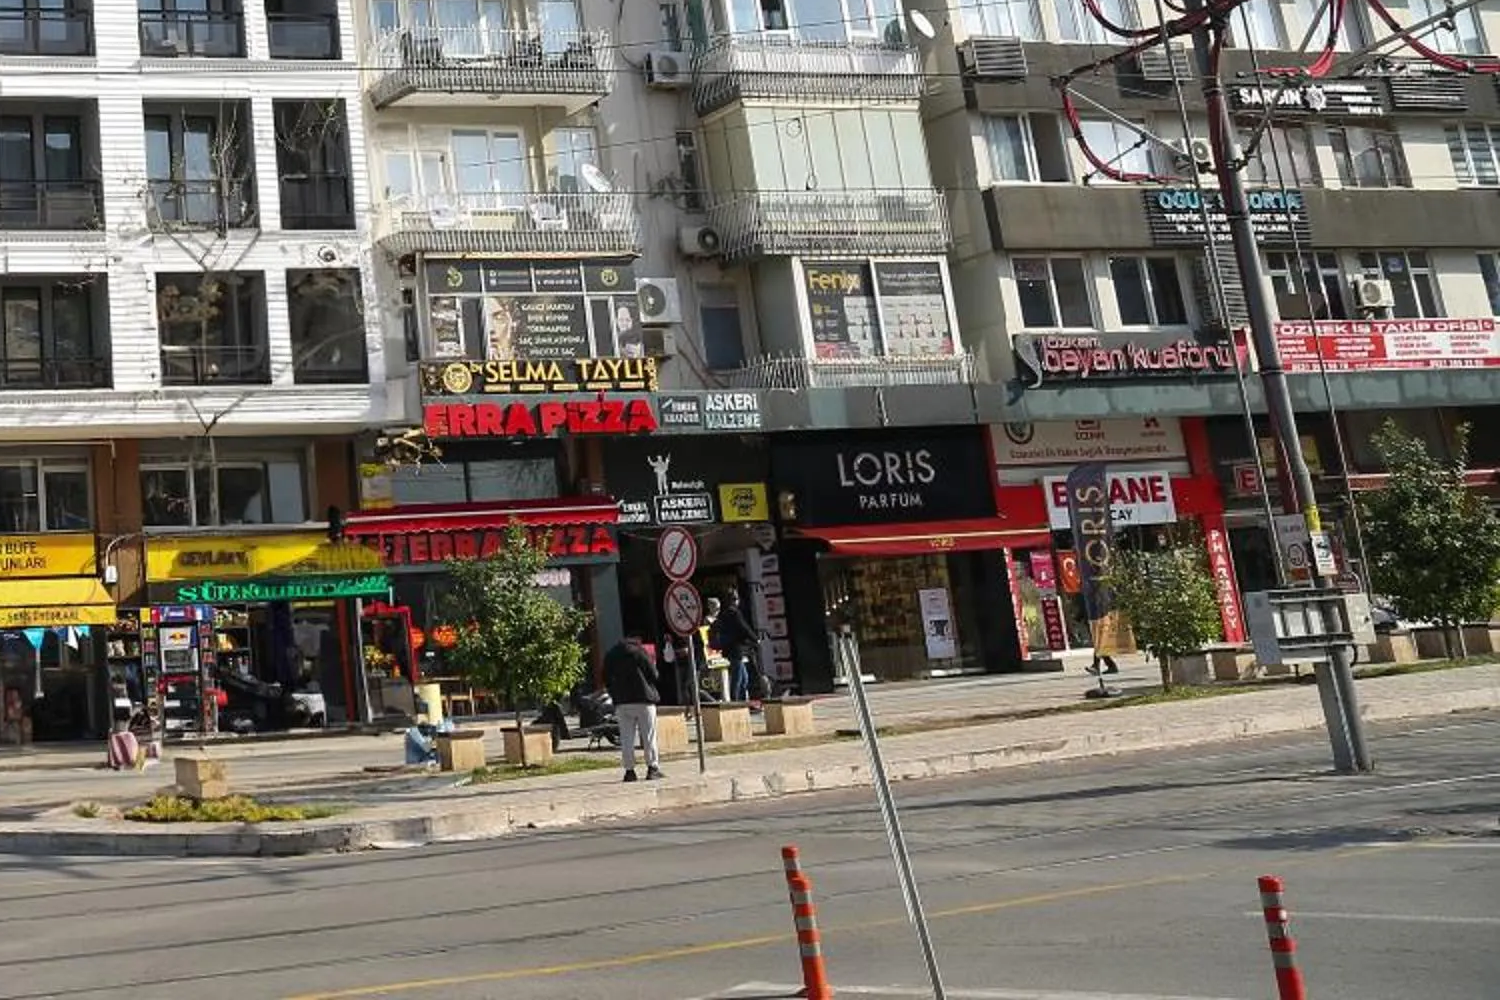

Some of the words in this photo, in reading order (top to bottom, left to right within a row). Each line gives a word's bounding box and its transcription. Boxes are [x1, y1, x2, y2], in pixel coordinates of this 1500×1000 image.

[1373, 321, 1428, 337] TAKİP
[485, 361, 565, 383] SELMA
[705, 393, 758, 412] ASKERİ
[541, 398, 658, 434] PİZZA
[837, 449, 936, 487] LORIS
[1051, 475, 1168, 508] EANE
[5, 540, 37, 555] BÜFE
